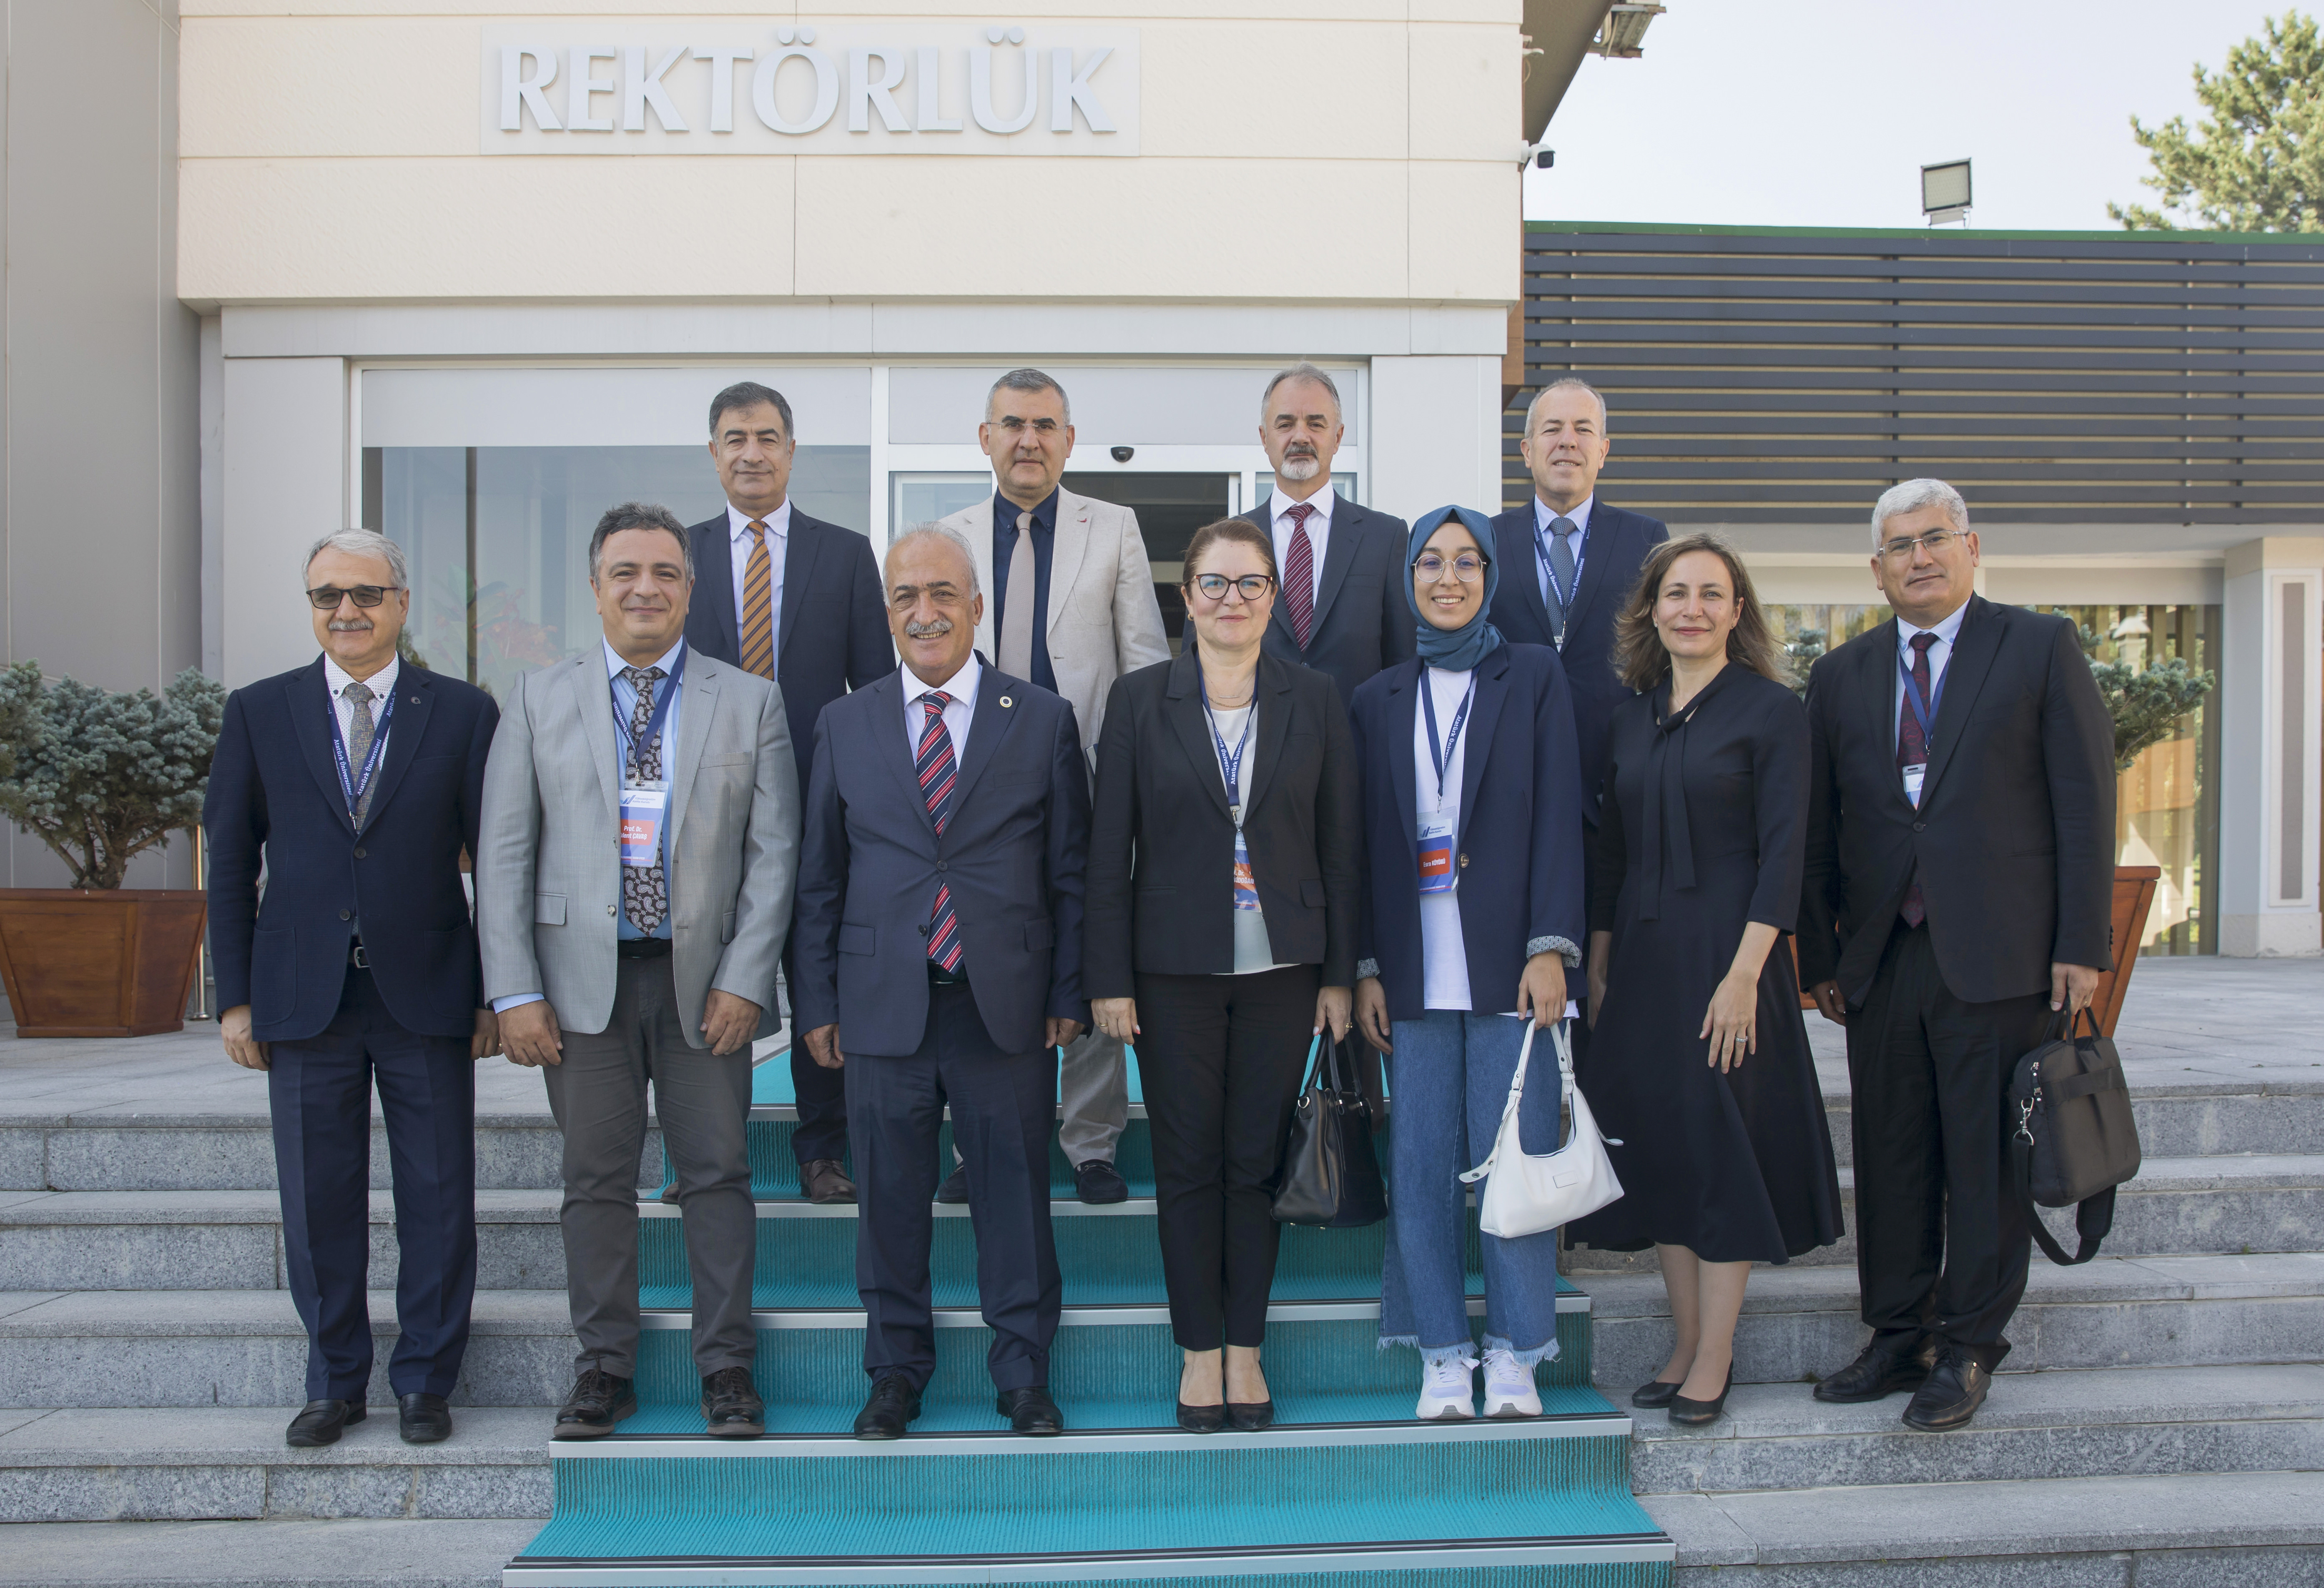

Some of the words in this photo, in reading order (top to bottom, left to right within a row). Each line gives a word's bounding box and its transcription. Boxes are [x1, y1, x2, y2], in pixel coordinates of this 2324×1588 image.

[500, 25, 1118, 135] REKTÖRLÜK
[1573, 558, 1584, 587] Üniversitesi
[1451, 715, 1462, 737] Atatürk
[334, 739, 344, 761] Atatürk
[340, 761, 353, 795] Üniversitesi
[357, 772, 370, 796] Atatürk
[364, 738, 381, 771] Üniversitesi
